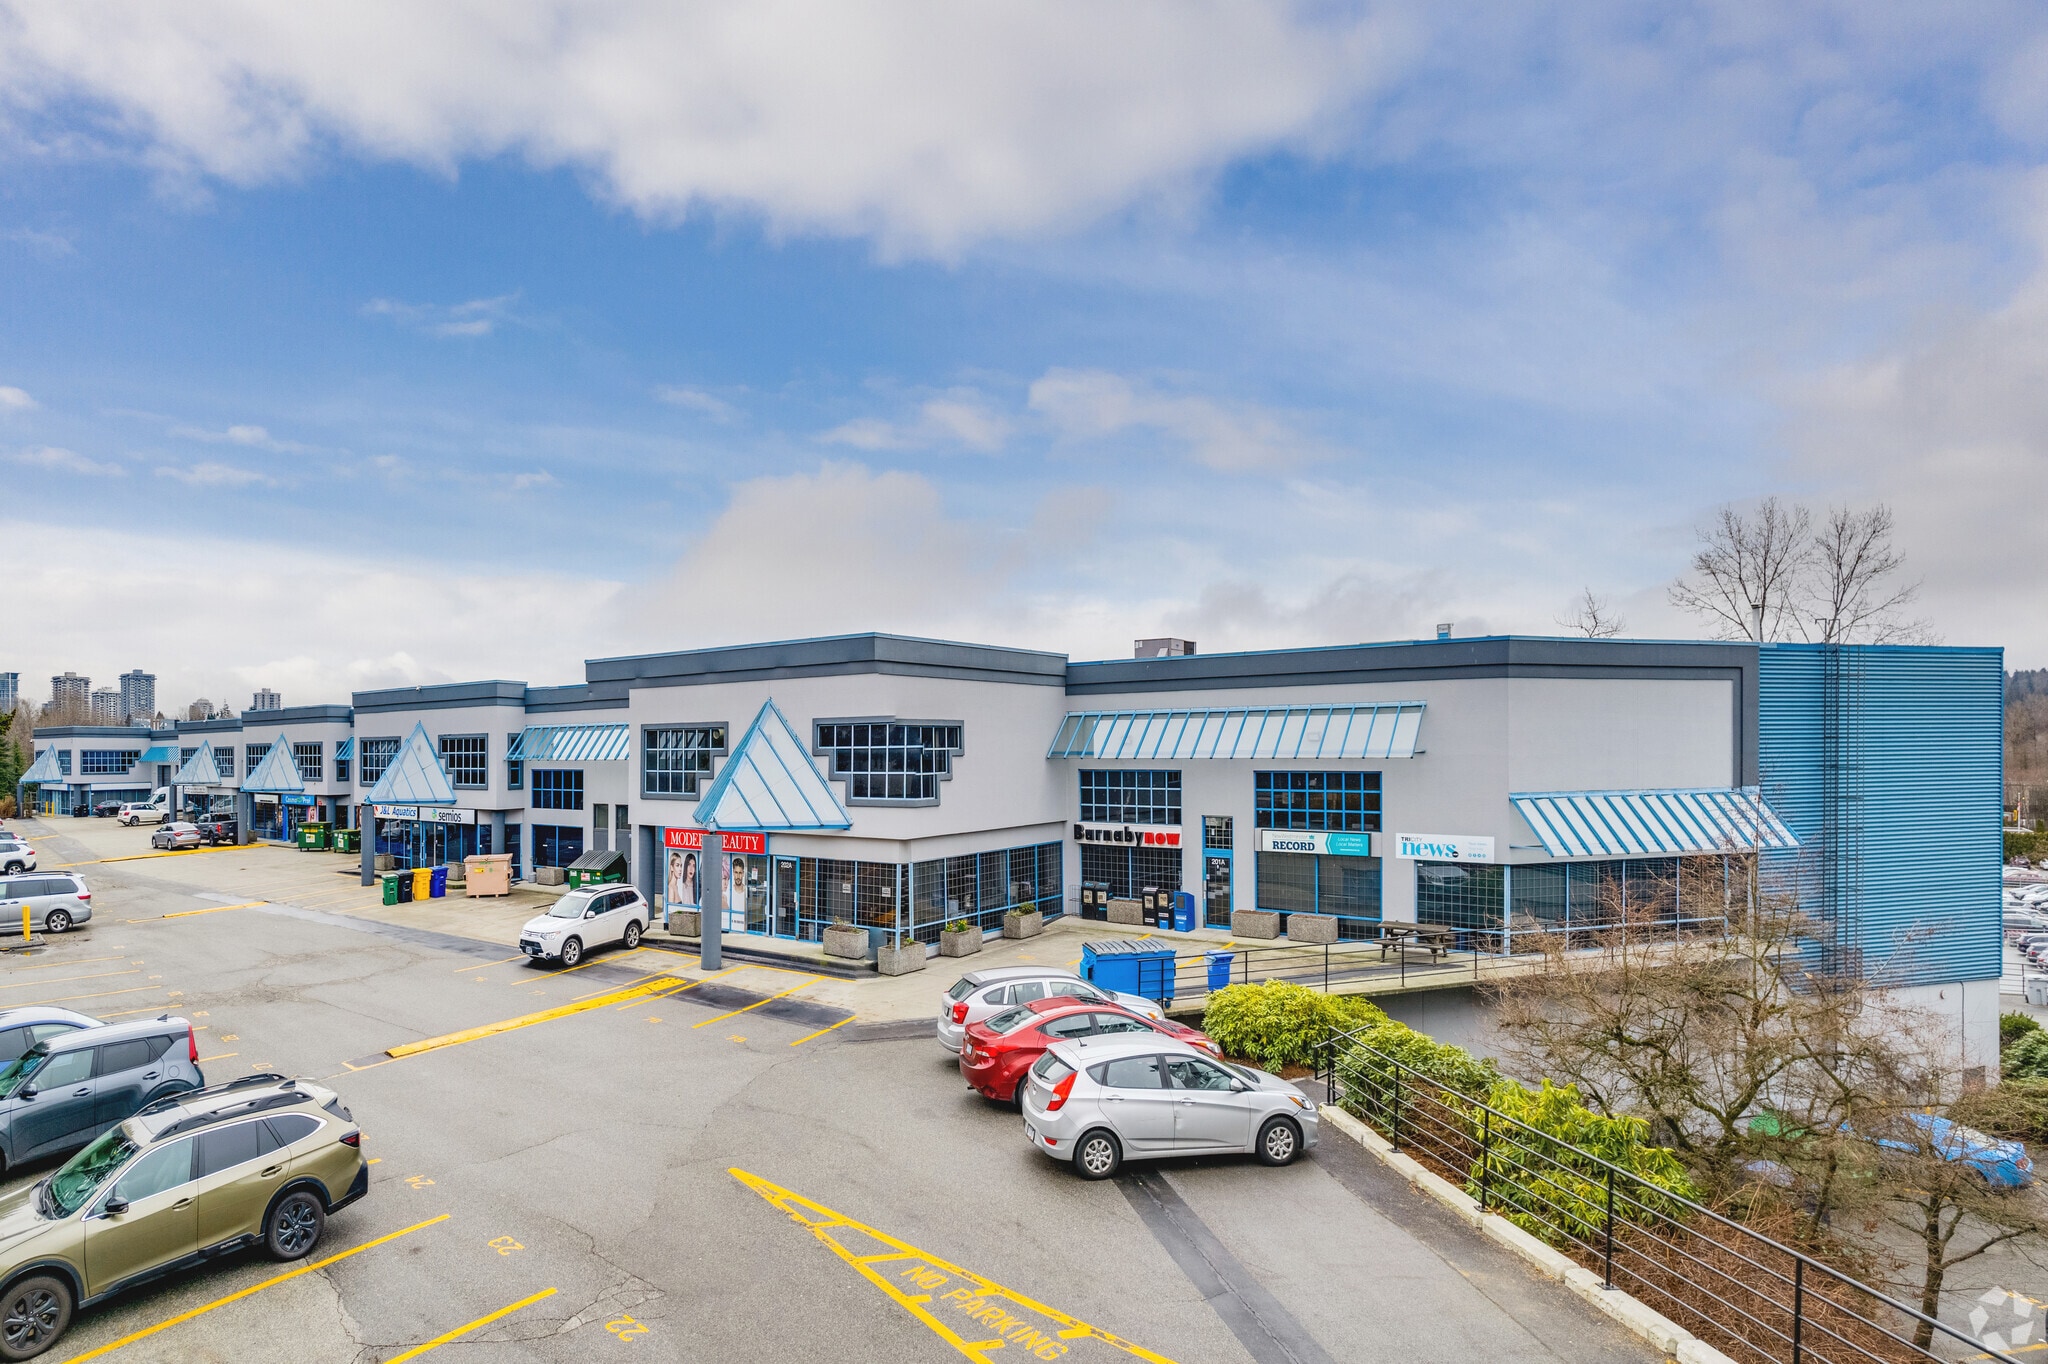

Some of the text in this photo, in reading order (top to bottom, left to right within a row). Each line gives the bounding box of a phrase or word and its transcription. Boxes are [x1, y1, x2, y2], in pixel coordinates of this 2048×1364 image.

[392, 806, 416, 817] Aquatics
[438, 810, 462, 823] semios
[722, 834, 760, 851] EAUTY
[1272, 840, 1315, 851] RECORD
[1401, 841, 1457, 858] news
[1211, 858, 1226, 866] 201A
[404, 1174, 436, 1190] 24
[486, 1235, 526, 1257] 23
[900, 1255, 949, 1290] NO
[604, 1314, 650, 1342] 22
[940, 1287, 1069, 1361] PARKING
